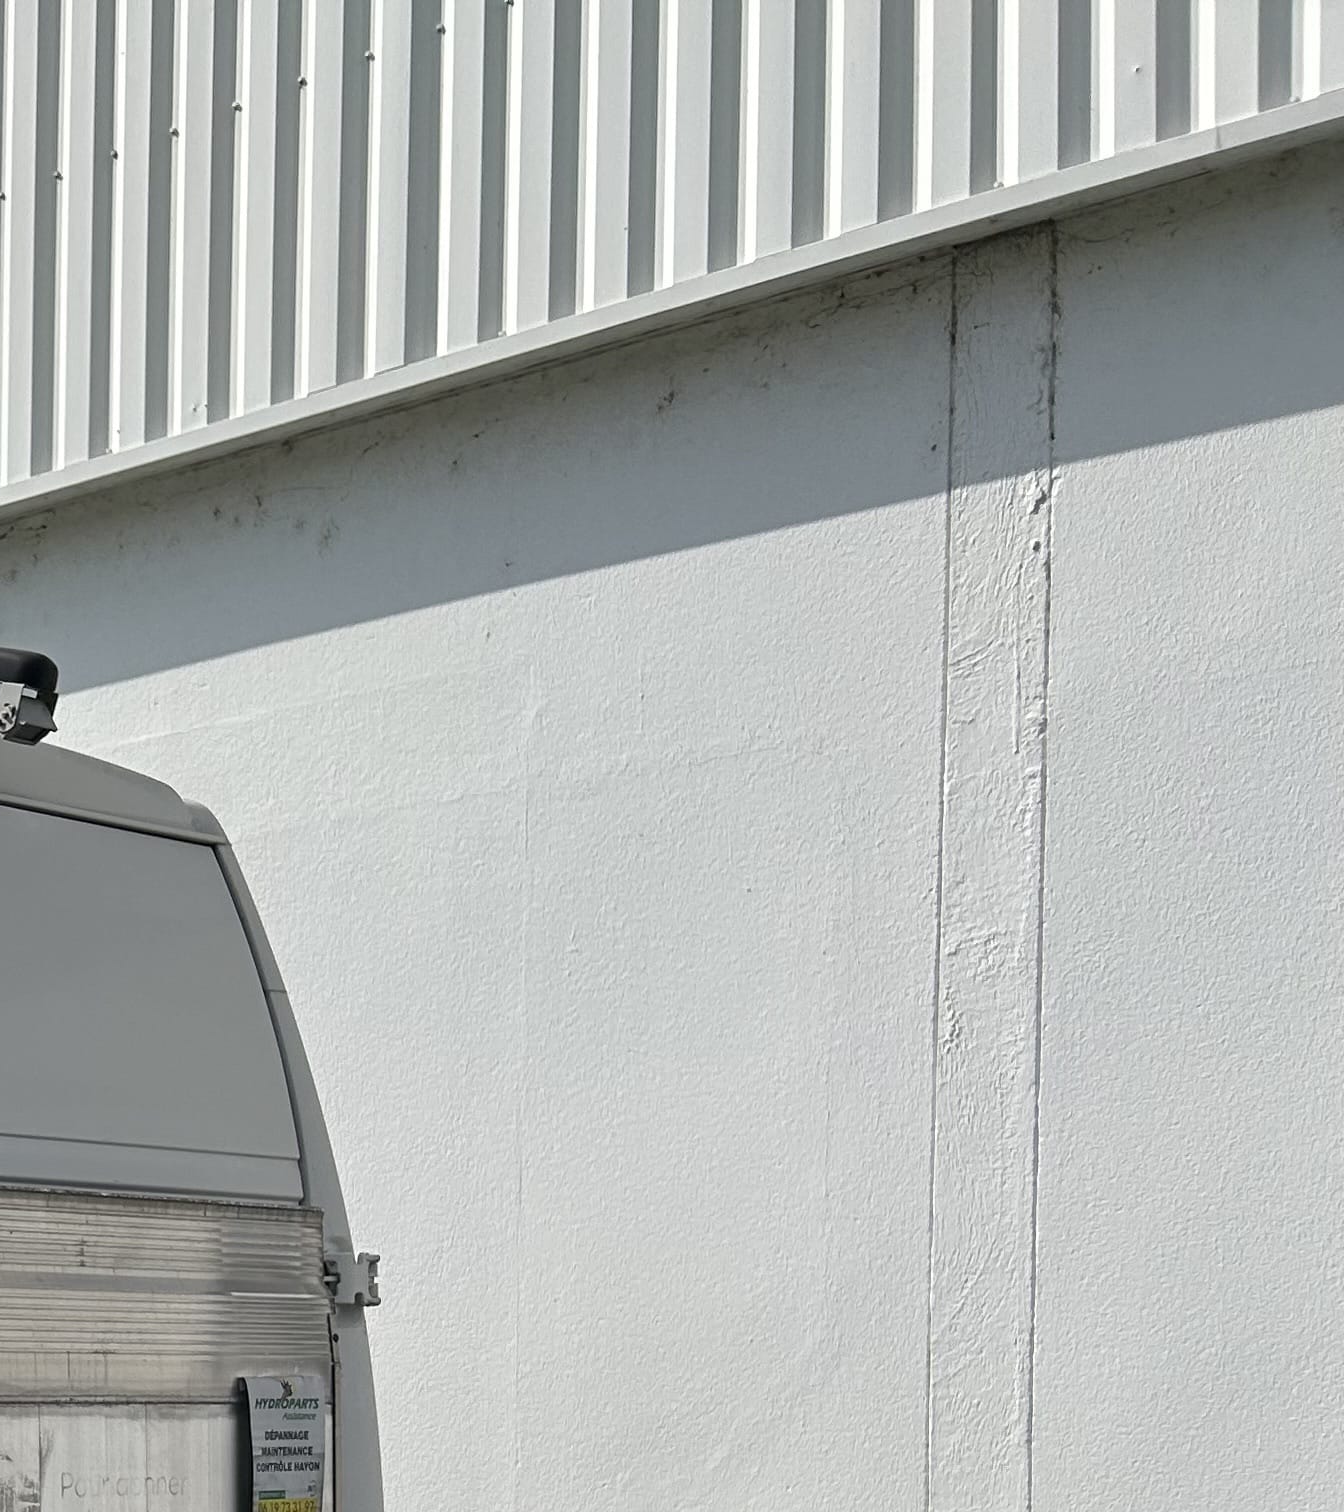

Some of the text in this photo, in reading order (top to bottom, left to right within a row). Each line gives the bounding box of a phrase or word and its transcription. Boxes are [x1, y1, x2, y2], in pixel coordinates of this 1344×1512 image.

[254, 1398, 319, 1410] HYDROPARTS
[264, 1429, 309, 1441] DÉPANNAGE
[262, 1446, 313, 1457] MAINTENANCE
[294, 1461, 320, 1472] HAYON
